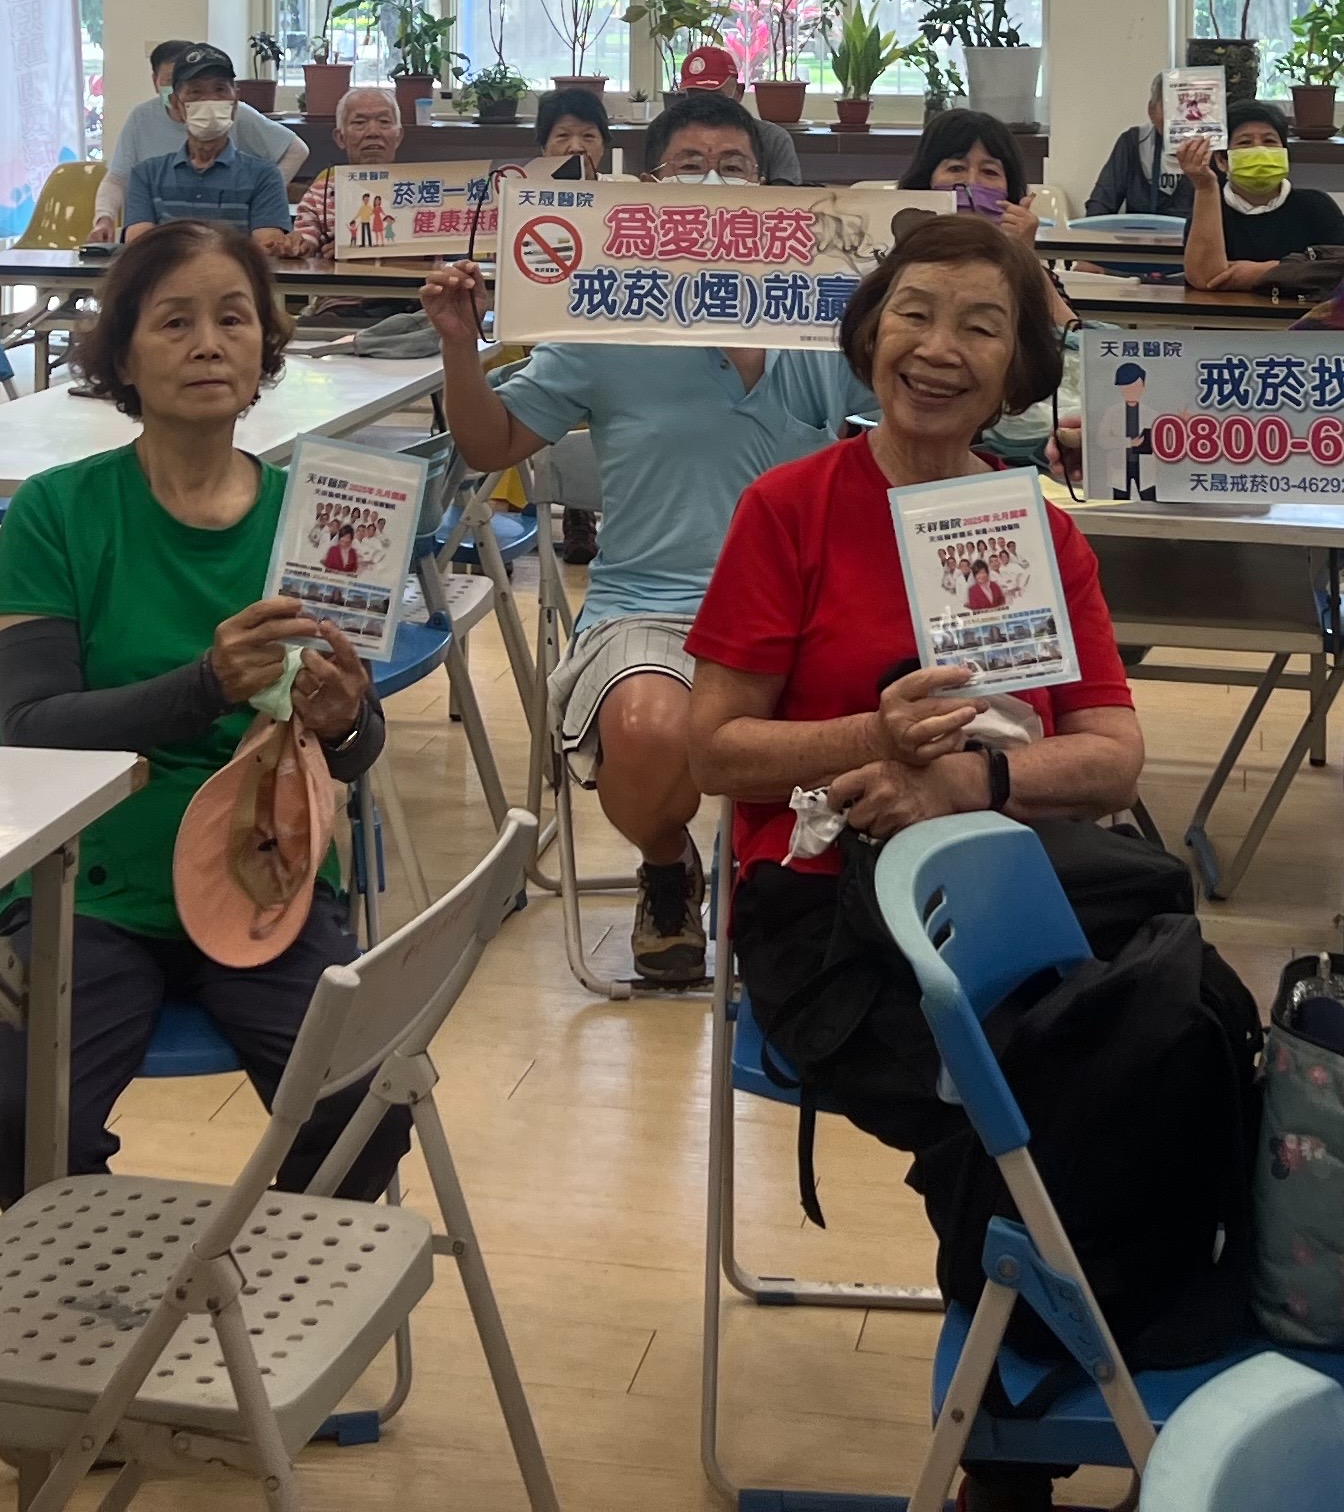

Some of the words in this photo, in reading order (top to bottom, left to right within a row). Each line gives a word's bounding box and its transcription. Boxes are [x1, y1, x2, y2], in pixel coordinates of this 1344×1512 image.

[518, 191, 595, 208] 天晟醫院
[1099, 341, 1183, 358] 天晟醫院
